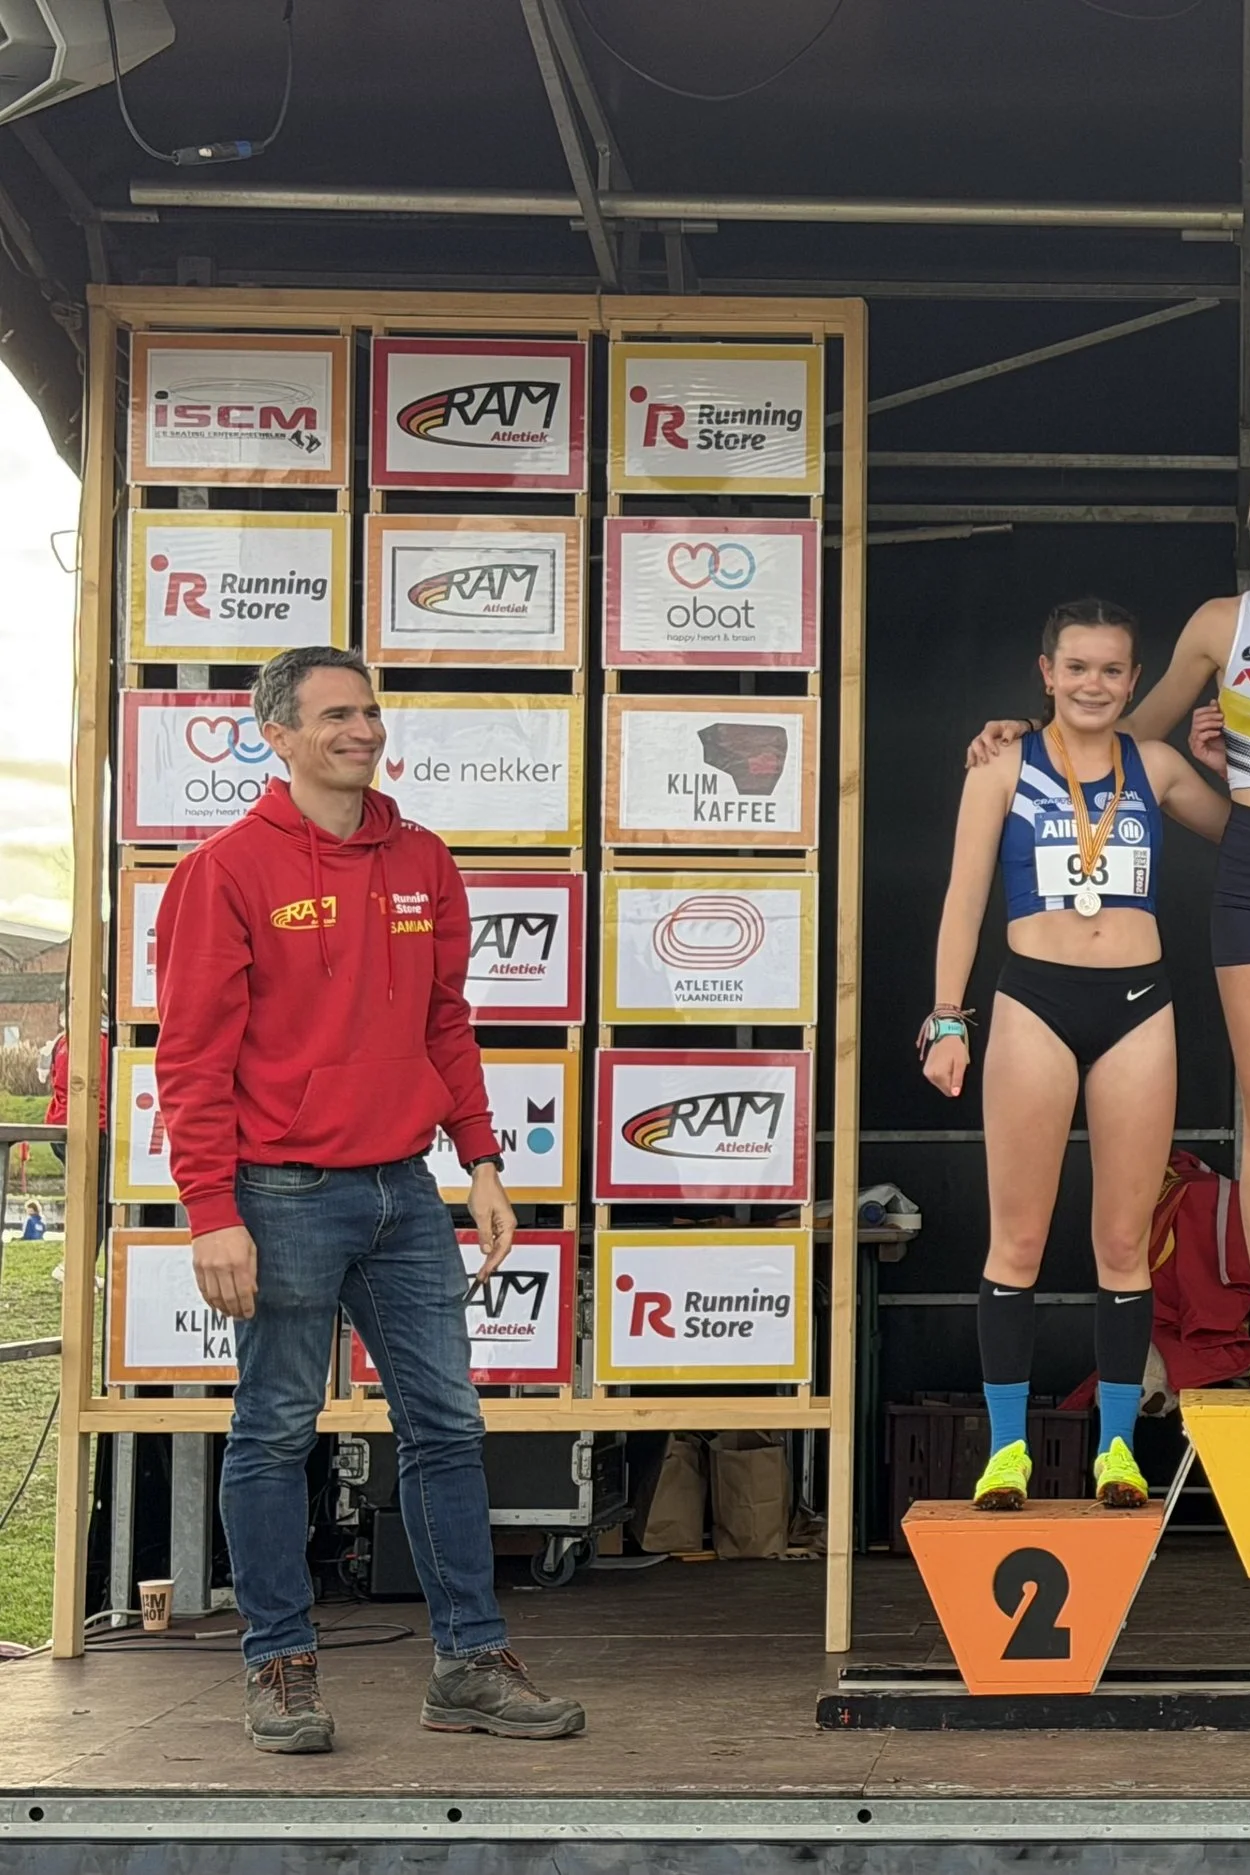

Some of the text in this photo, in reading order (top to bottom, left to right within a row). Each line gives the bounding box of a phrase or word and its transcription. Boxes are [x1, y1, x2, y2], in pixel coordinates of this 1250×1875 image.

[442, 381, 560, 429] RAM
[698, 402, 802, 432] Running
[491, 431, 548, 443] Atletiek
[696, 429, 766, 450] Store
[220, 570, 327, 600] Running
[444, 564, 538, 601] RAM
[219, 598, 290, 619] Store
[483, 604, 527, 613] Atletiek
[667, 596, 755, 629] obat
[667, 633, 695, 642] happy
[697, 633, 720, 641] heart
[732, 633, 756, 641] brain
[414, 756, 562, 782] de nekker
[668, 774, 717, 800] KLIM
[185, 808, 214, 816] happy
[694, 801, 776, 822] KAFFEE
[1041, 819, 1115, 838] Alli
[1067, 854, 1109, 886] 93
[392, 892, 428, 904] Runnin
[471, 913, 558, 960] AM
[489, 964, 546, 974] Atletiek
[674, 980, 743, 991] ATLETIEK
[668, 1091, 785, 1139] RAM
[715, 1142, 773, 1153] Atletiek
[462, 1271, 549, 1320] AM
[684, 1288, 790, 1317] Running
[475, 1323, 536, 1335] Atletiek
[684, 1317, 753, 1338] Store
[993, 1546, 1070, 1660] 2
